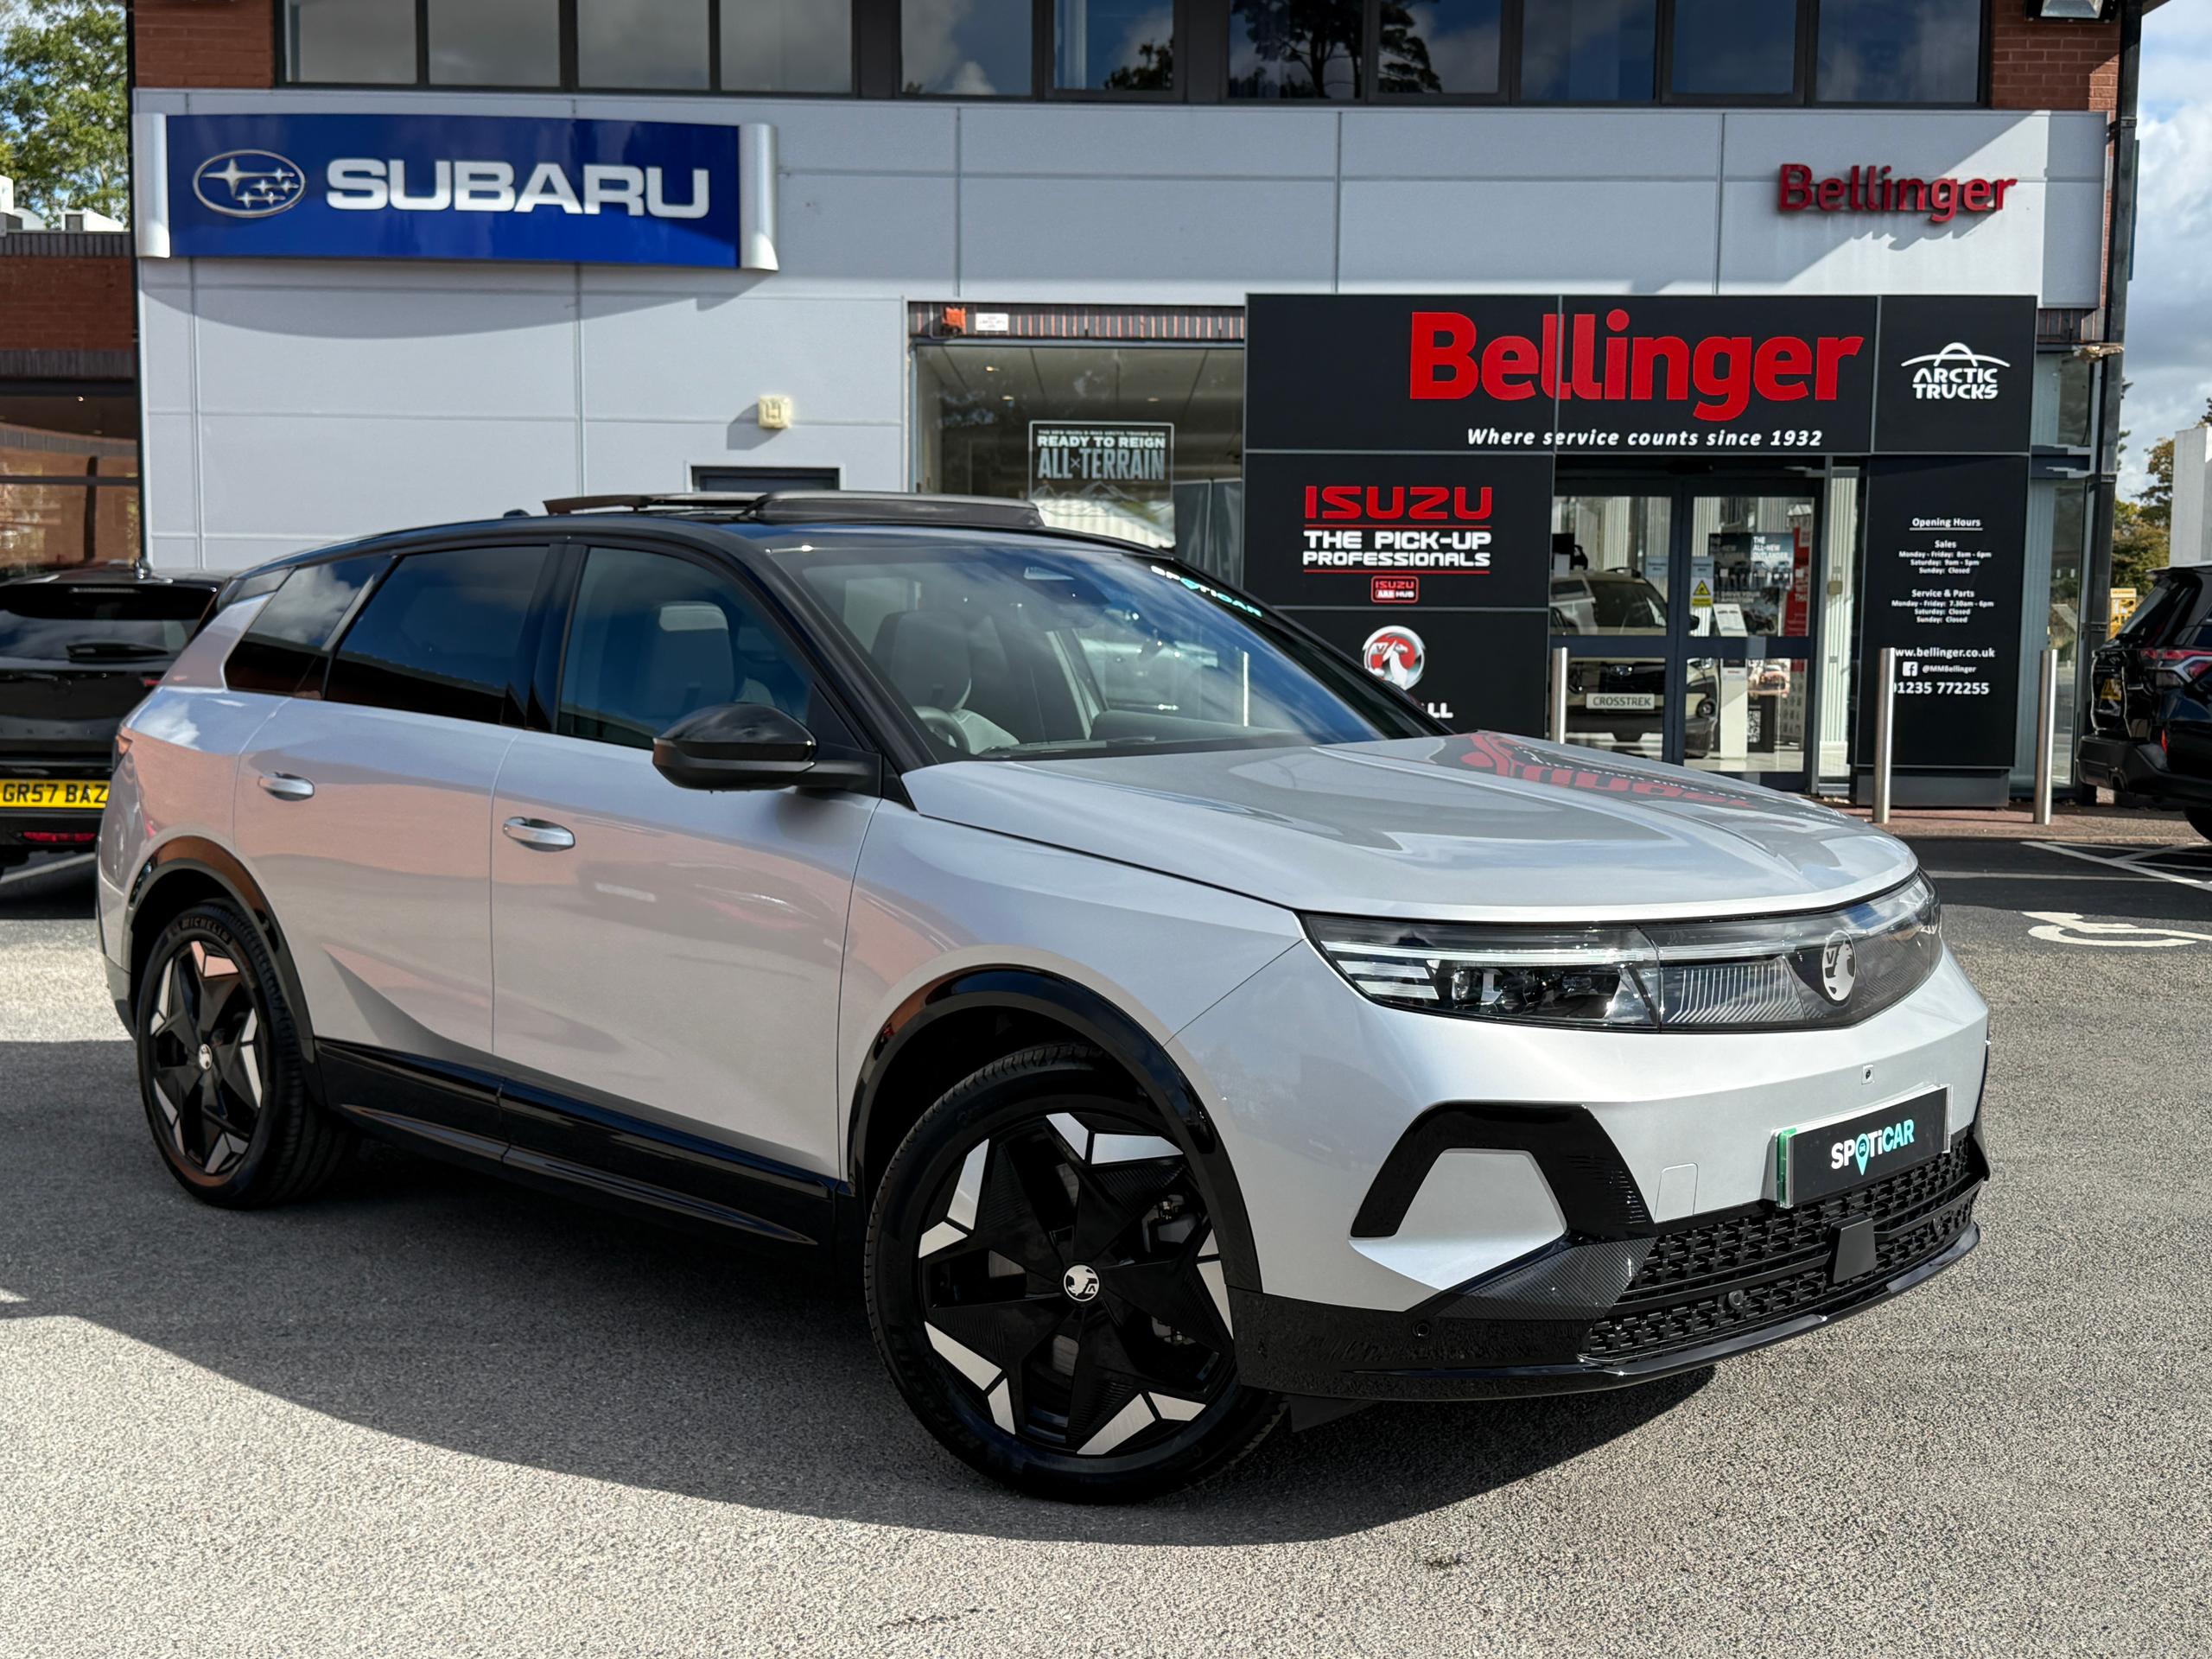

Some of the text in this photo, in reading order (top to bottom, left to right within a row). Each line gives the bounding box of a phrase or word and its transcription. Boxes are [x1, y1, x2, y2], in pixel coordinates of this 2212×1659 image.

[327, 158, 709, 219] SUBARU
[1778, 163, 2018, 222] Bellinger
[1409, 308, 1865, 422] Bellinger
[1912, 367, 1998, 383] ARCTIC
[1912, 384, 1999, 399] TRUCKS
[1037, 435, 1166, 448] READY TO REIGN
[1468, 428, 1822, 446] Where service counts since 1932
[1305, 486, 1493, 519] ISUZU
[1912, 518, 1981, 528] Opening Hours
[1303, 531, 1492, 550] THE PICK-UP
[1935, 540, 1957, 549] Sales
[1303, 551, 1491, 567] PROFESSIONALS
[1898, 550, 1926, 559] Monday
[1375, 581, 1414, 589] ISUZU
[1911, 589, 1942, 598] Service
[1894, 647, 1995, 658] ww.bellinger.co.uk
[1936, 682, 1990, 695] 772255
[1592, 696, 1651, 707] CROSSTREK
[3, 783, 108, 804] GR57 BAZ
